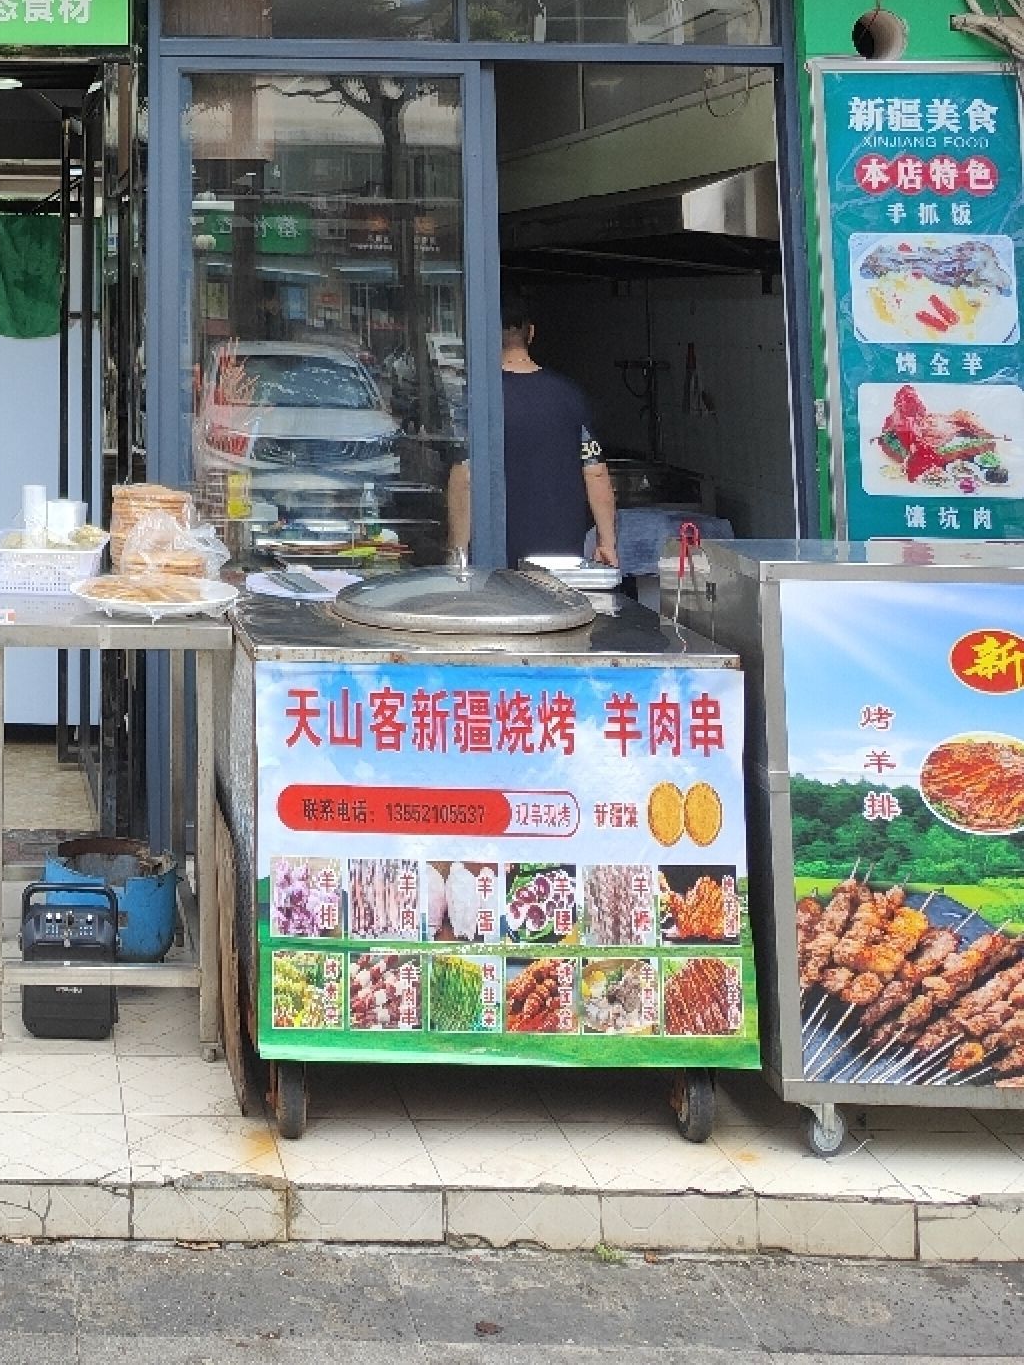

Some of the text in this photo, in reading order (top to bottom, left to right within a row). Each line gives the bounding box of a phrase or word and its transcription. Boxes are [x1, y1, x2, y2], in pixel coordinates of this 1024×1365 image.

[848, 96, 998, 134] 新疆美食
[863, 137, 989, 149] XINJIANG FOOD
[861, 158, 994, 191] 本店特色
[886, 202, 972, 225] 手抓饭
[896, 352, 983, 376] 烤全羊
[904, 504, 992, 530] 馕坑肉
[284, 687, 726, 758] 天山客新疆烧烤 羊肉串
[860, 705, 901, 820] 烤羊排
[319, 869, 338, 929] 羊排
[399, 872, 417, 930] 羊肉
[477, 876, 495, 934] 羊蛋
[400, 963, 418, 1029] 羊肉串
